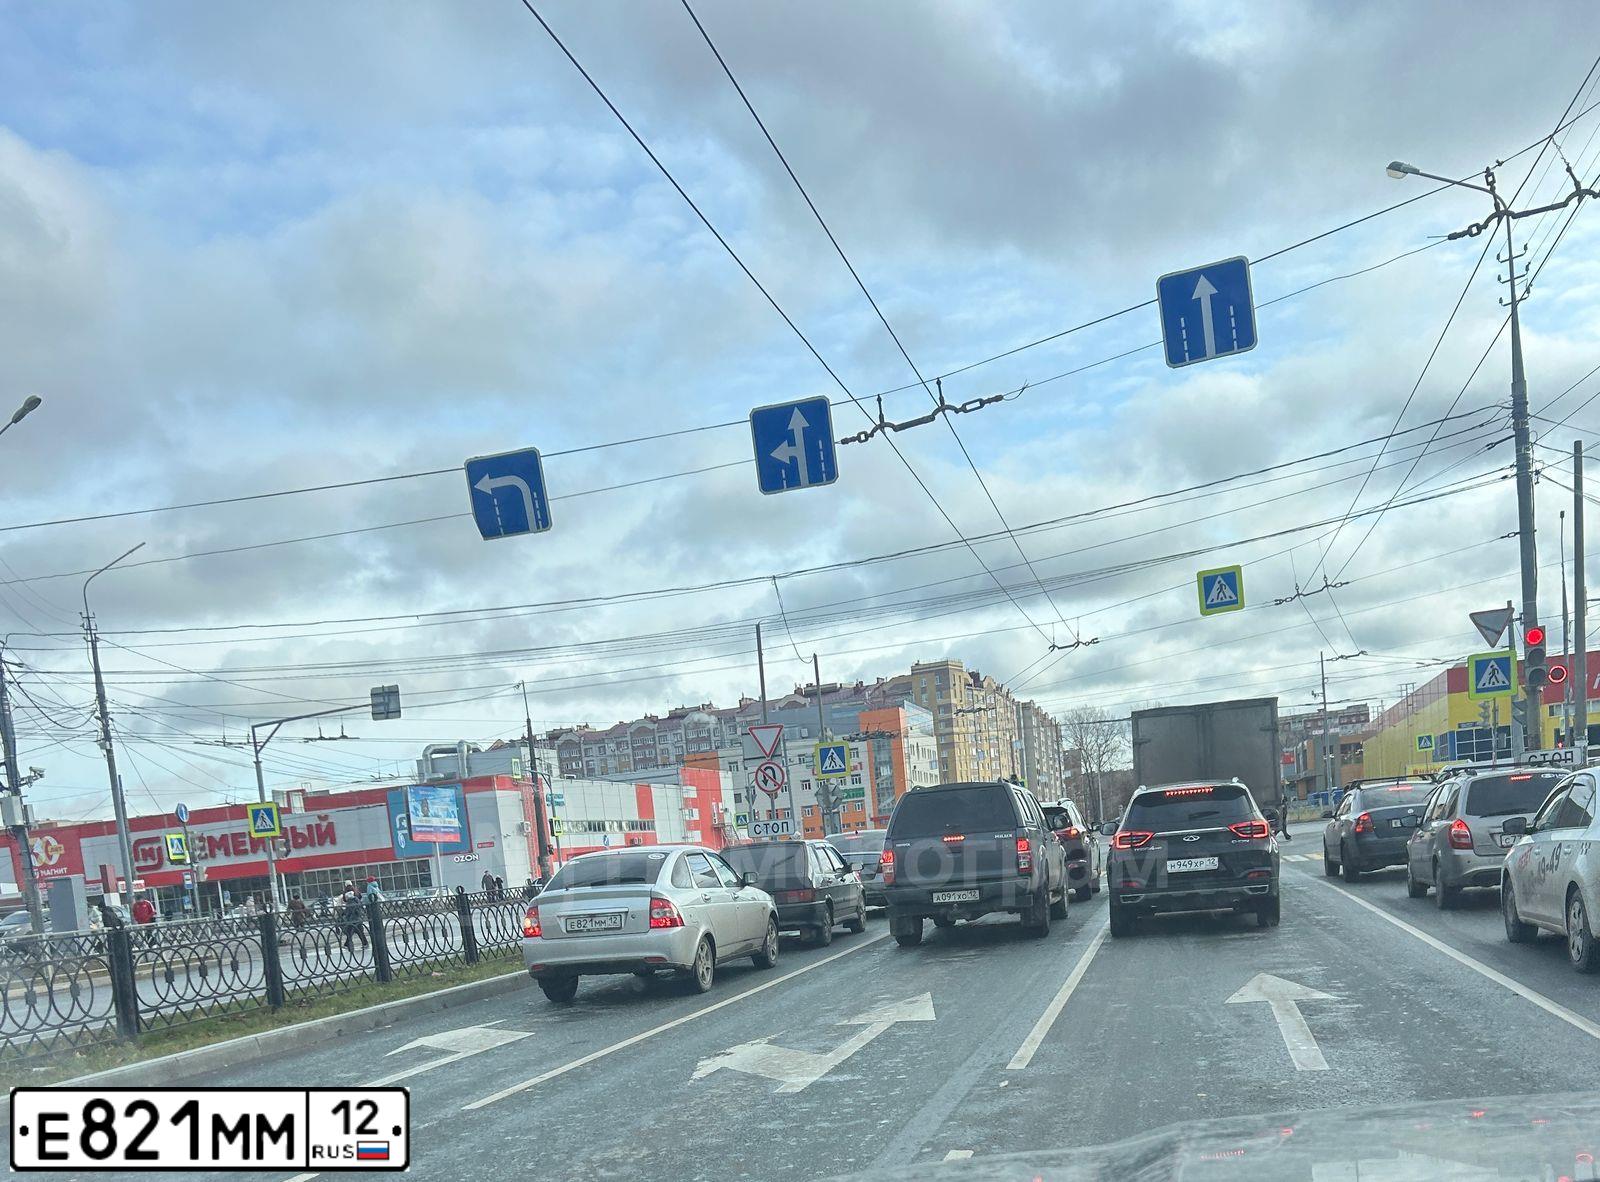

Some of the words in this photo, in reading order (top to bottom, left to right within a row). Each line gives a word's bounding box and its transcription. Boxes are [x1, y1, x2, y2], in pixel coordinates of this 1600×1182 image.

[753, 821, 789, 835] СТОП
[453, 853, 479, 863] OZON
[1207, 857, 1216, 865] 12
[40, 867, 68, 877] МАГНИТ
[570, 918, 607, 930] Е821ММ
[608, 916, 618, 925] 12
